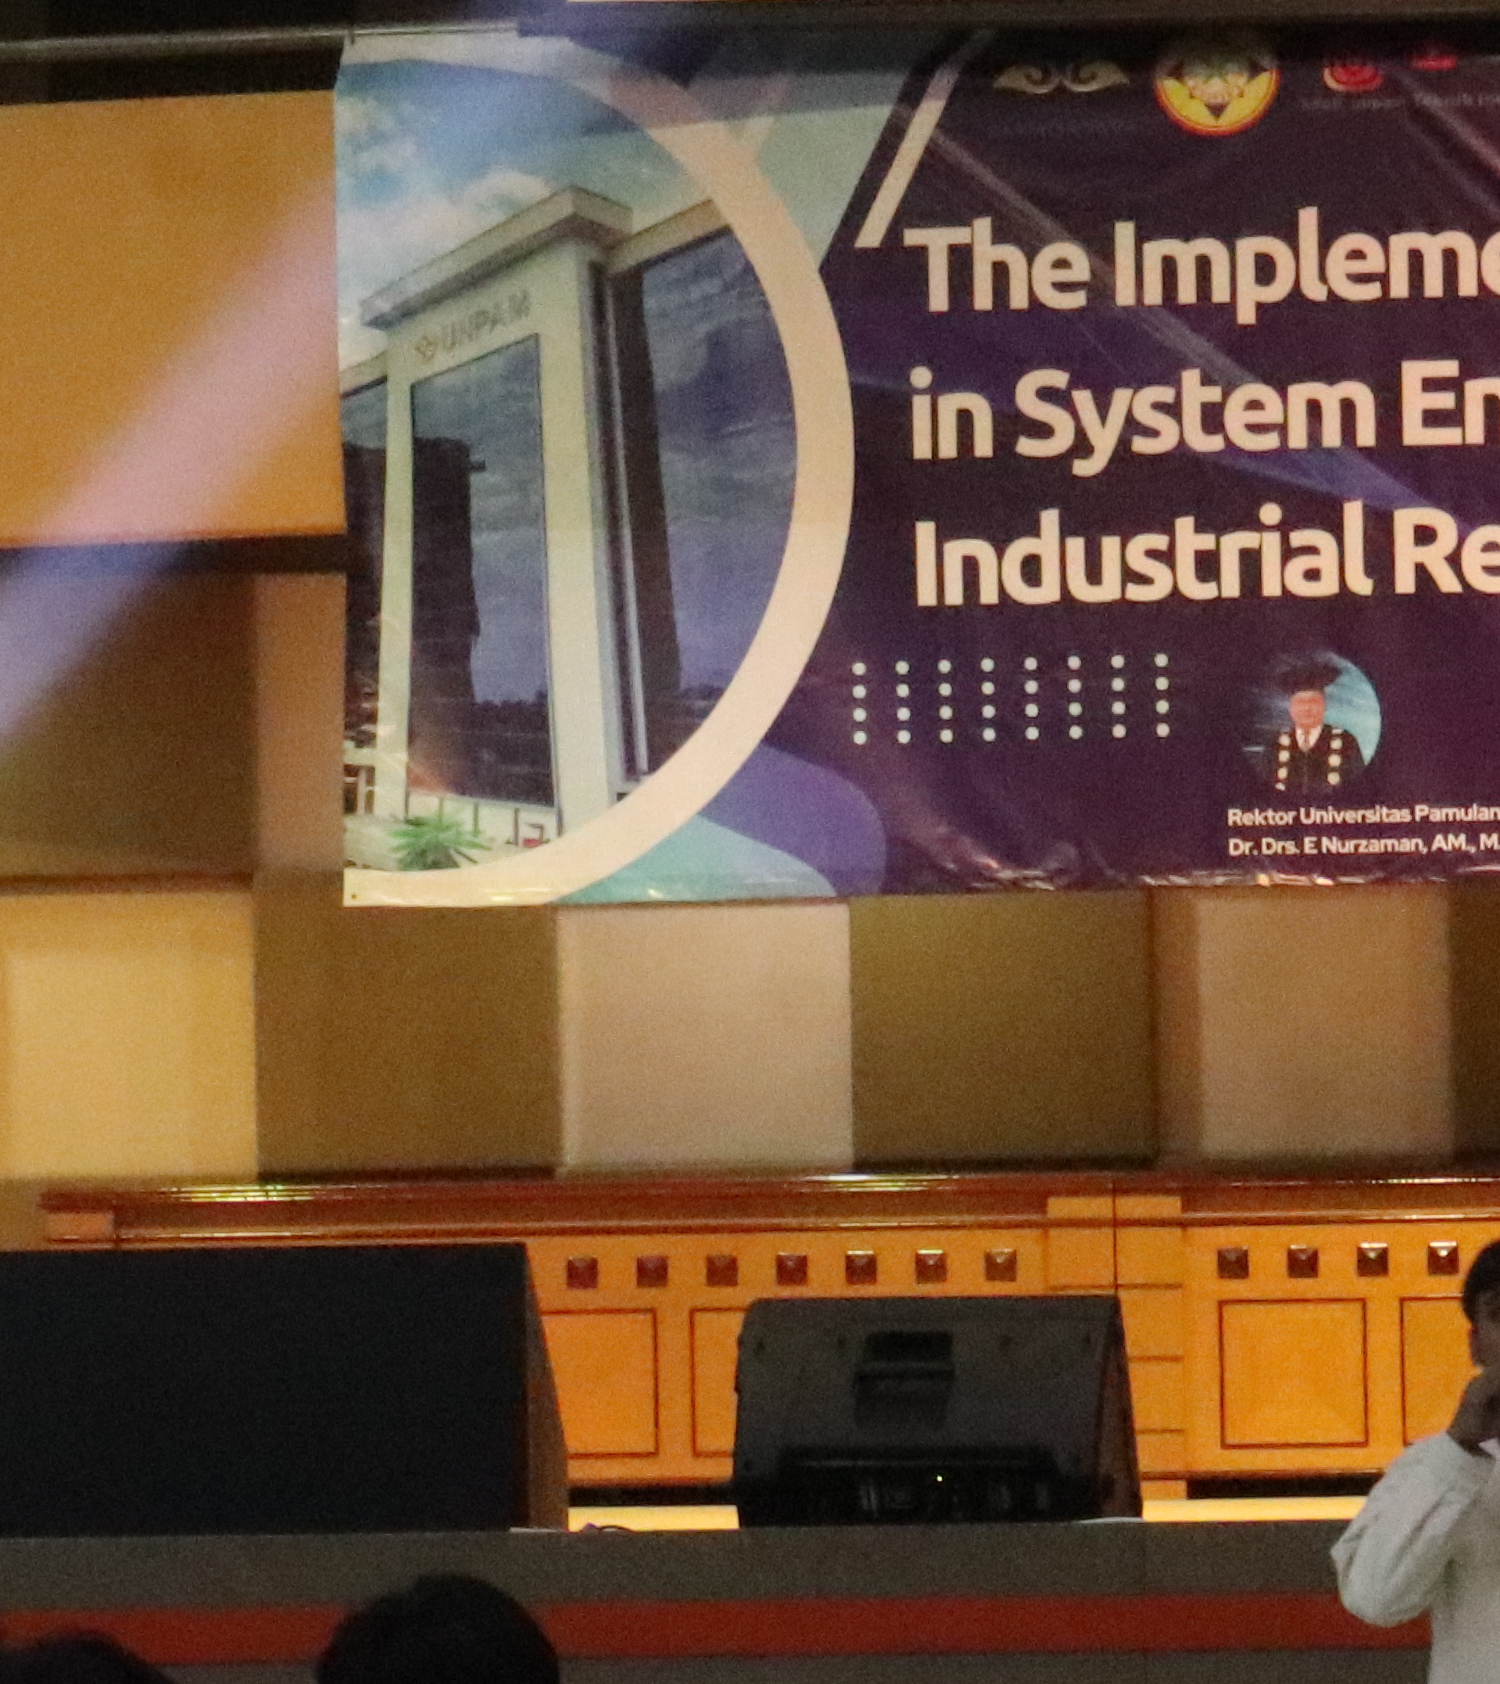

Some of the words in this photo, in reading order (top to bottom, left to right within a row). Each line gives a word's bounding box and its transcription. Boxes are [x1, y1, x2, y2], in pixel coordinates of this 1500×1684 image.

[903, 216, 1092, 312] The
[909, 365, 994, 460] in
[1014, 368, 1377, 478] System
[914, 500, 1375, 608] Industrial
[1227, 808, 1296, 828] Rektor
[1299, 806, 1412, 826] Universitas
[1228, 838, 1259, 857] Dr.
[1261, 837, 1300, 856] Drs.
[1303, 836, 1319, 855] E
[1321, 836, 1428, 856] Nurzaman,
